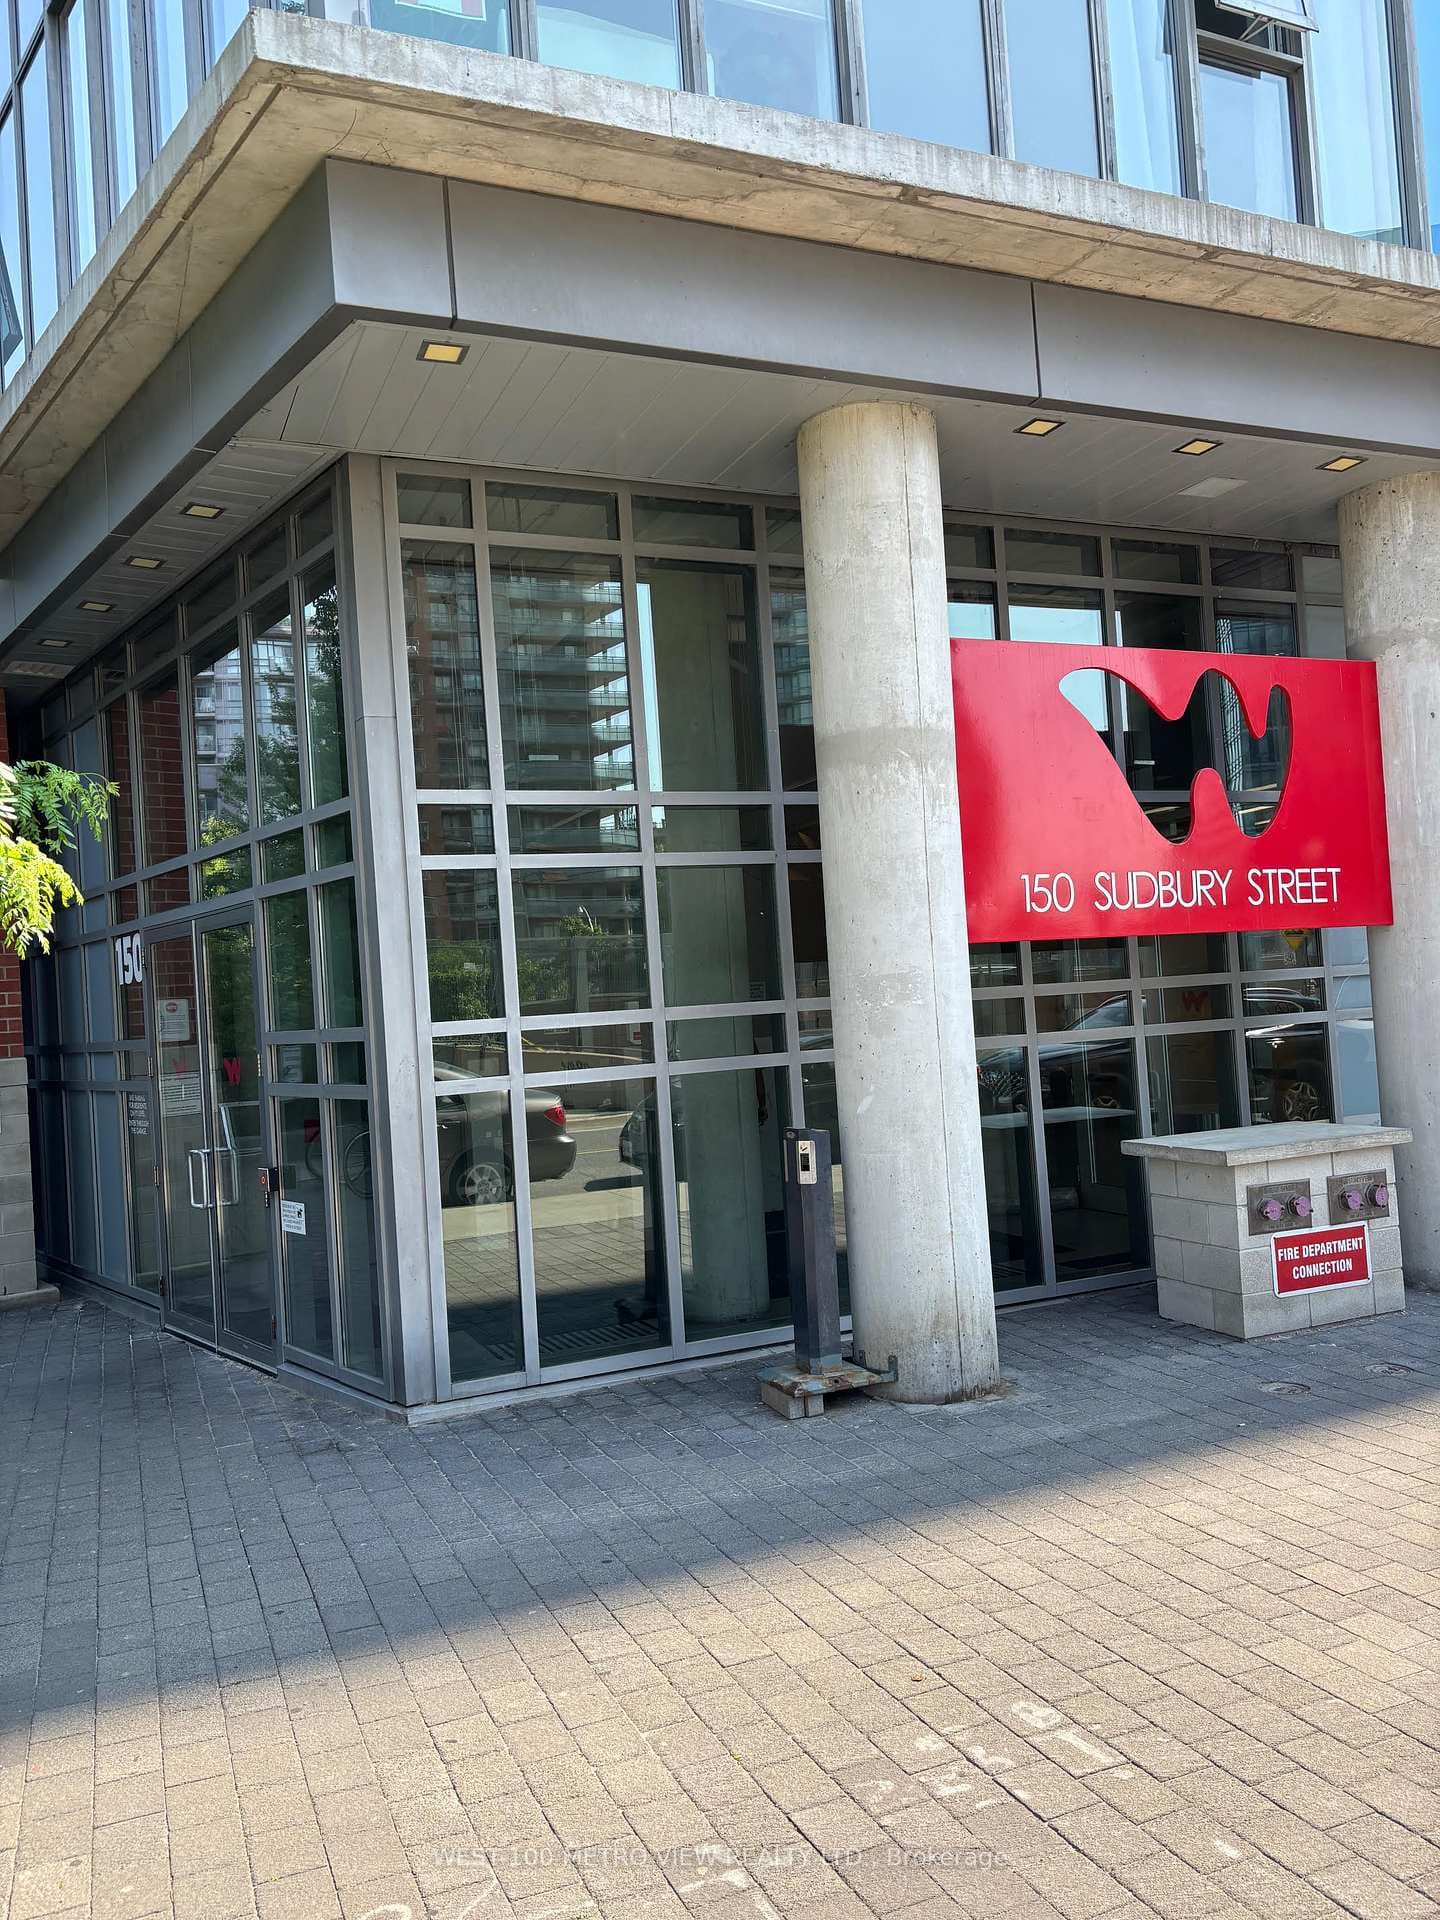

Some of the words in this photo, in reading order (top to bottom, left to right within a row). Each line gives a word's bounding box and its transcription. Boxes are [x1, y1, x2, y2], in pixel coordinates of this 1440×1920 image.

[1020, 872, 1075, 913] 150
[1094, 869, 1232, 911] SUDBURY
[1247, 867, 1342, 906] STREET
[115, 933, 143, 985] 150
[1278, 1246, 1300, 1262] FIRE
[1302, 1237, 1364, 1258] DEPARTMENT
[1292, 1258, 1353, 1280] CONNECTION
